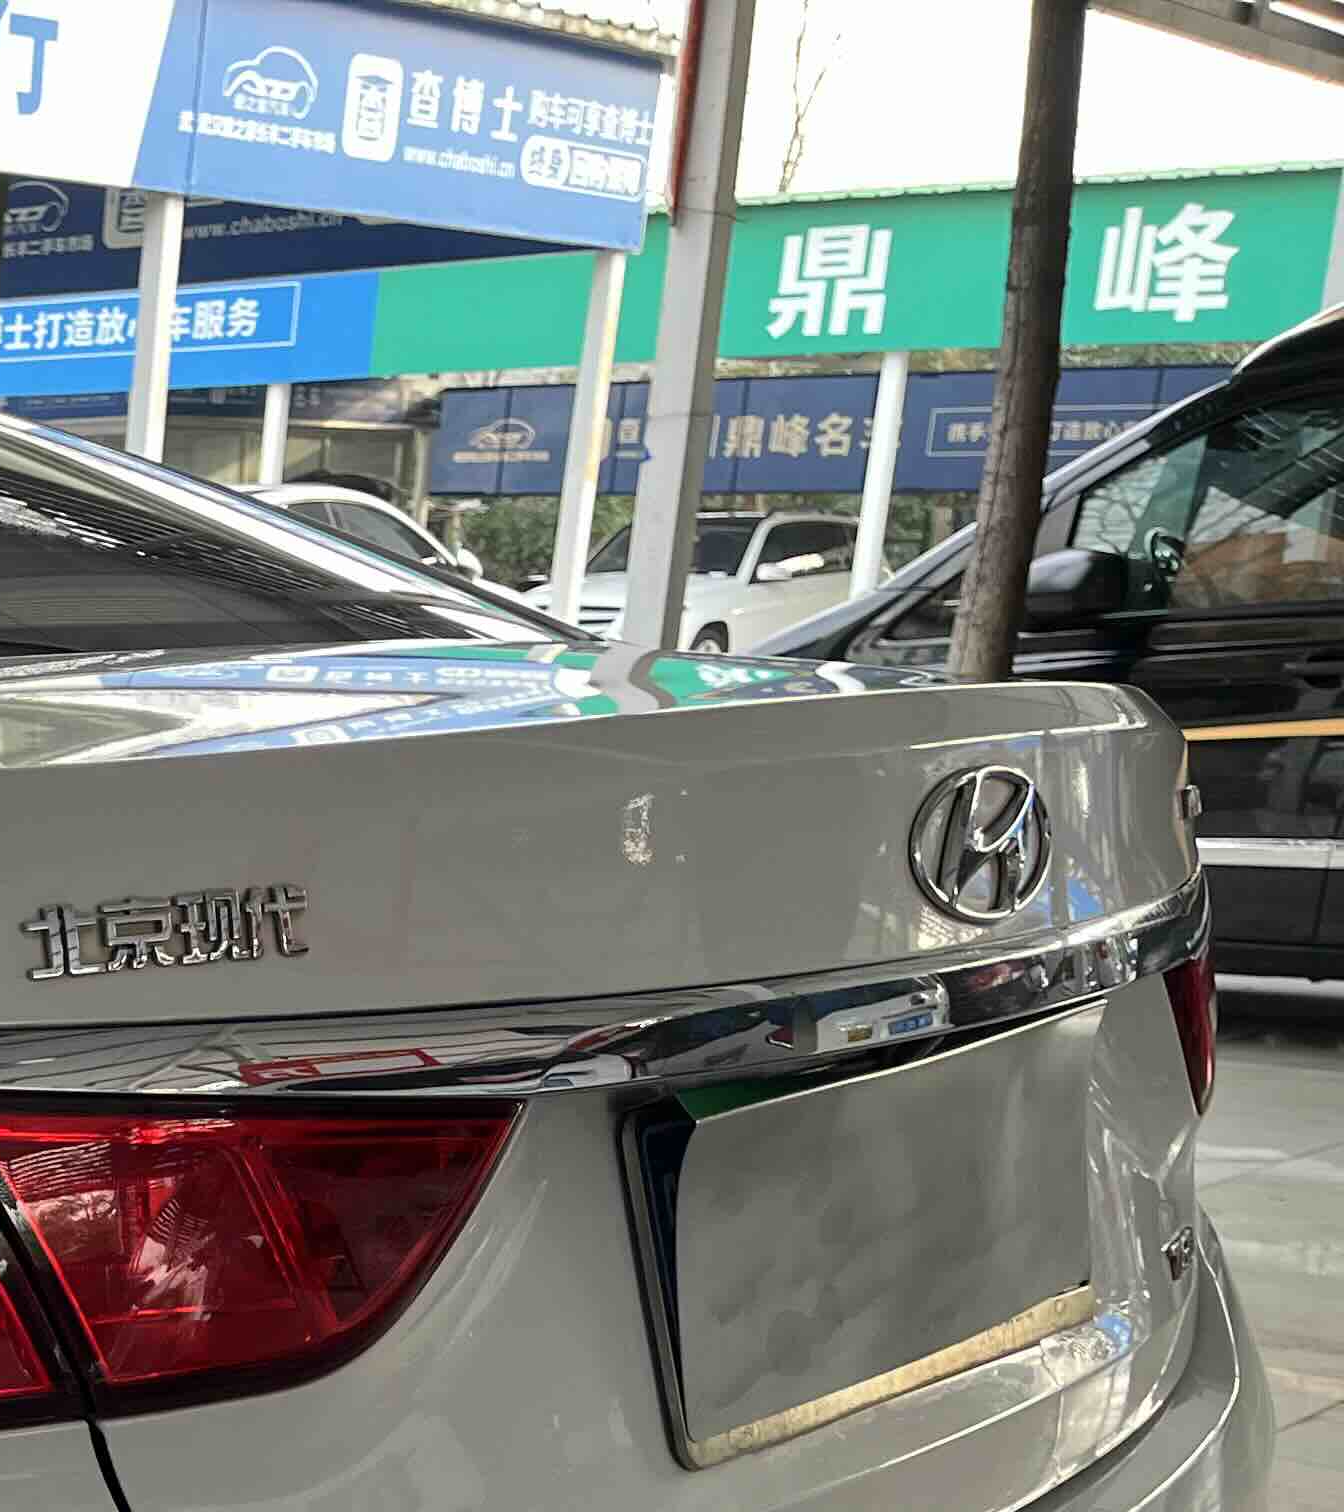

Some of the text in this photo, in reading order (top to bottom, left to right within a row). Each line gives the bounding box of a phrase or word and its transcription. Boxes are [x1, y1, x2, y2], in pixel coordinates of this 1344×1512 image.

[406, 69, 524, 143] 查博士
[766, 202, 1240, 339] 鼎峰
[19, 884, 311, 982] 北京现代
